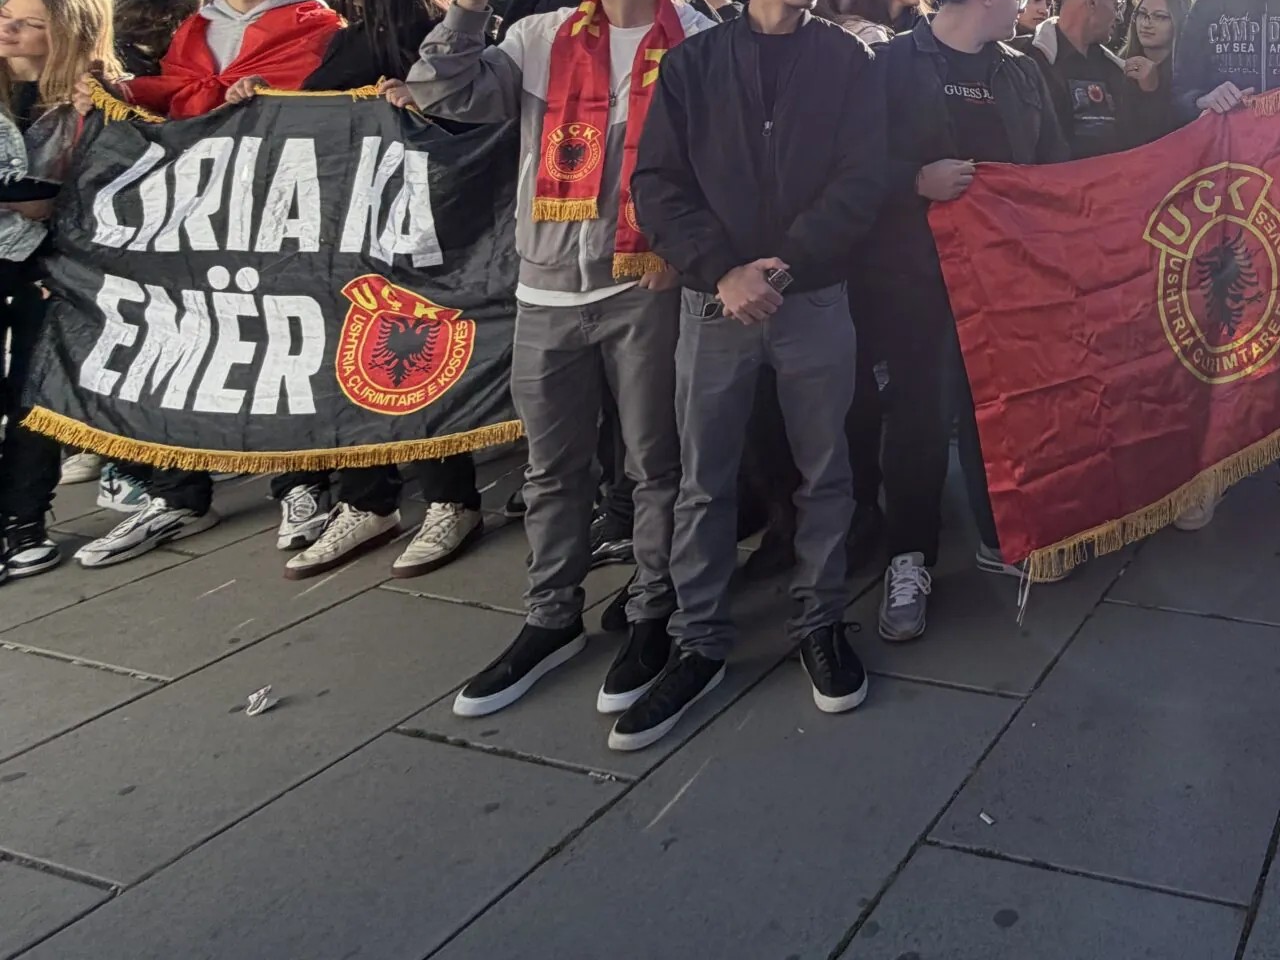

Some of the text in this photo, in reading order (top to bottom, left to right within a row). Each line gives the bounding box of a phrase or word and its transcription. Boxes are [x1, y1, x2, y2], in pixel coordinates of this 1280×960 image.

[1208, 21, 1260, 44] CAMP
[1216, 43, 1230, 53] BY
[1233, 43, 1255, 53] SEA
[944, 84, 982, 99] GUESS
[550, 124, 597, 143] UÇK
[92, 136, 444, 268] LIRIA KA
[351, 282, 445, 320] UÇK
[1165, 257, 1196, 353] USHTRIA
[79, 265, 326, 415] EMËR
[342, 314, 469, 407] USHTRIA ÇLIRIMTARE E KOSOVËS
